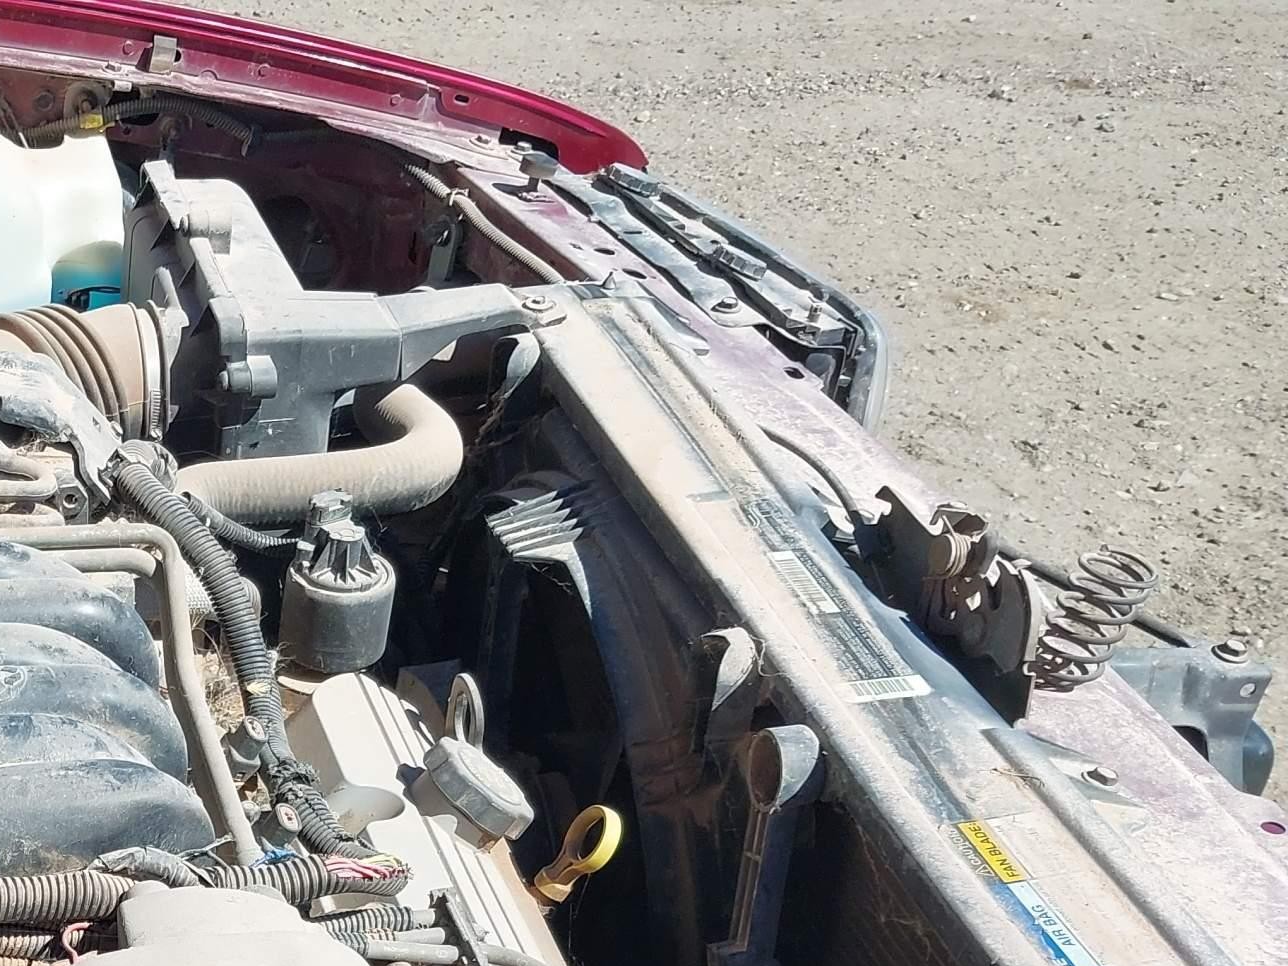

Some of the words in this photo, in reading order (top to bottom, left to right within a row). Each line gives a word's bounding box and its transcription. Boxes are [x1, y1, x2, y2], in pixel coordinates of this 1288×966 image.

[996, 858, 1020, 878] FAN
[1031, 904, 1057, 926] BAG
[1052, 928, 1076, 947] AIR
